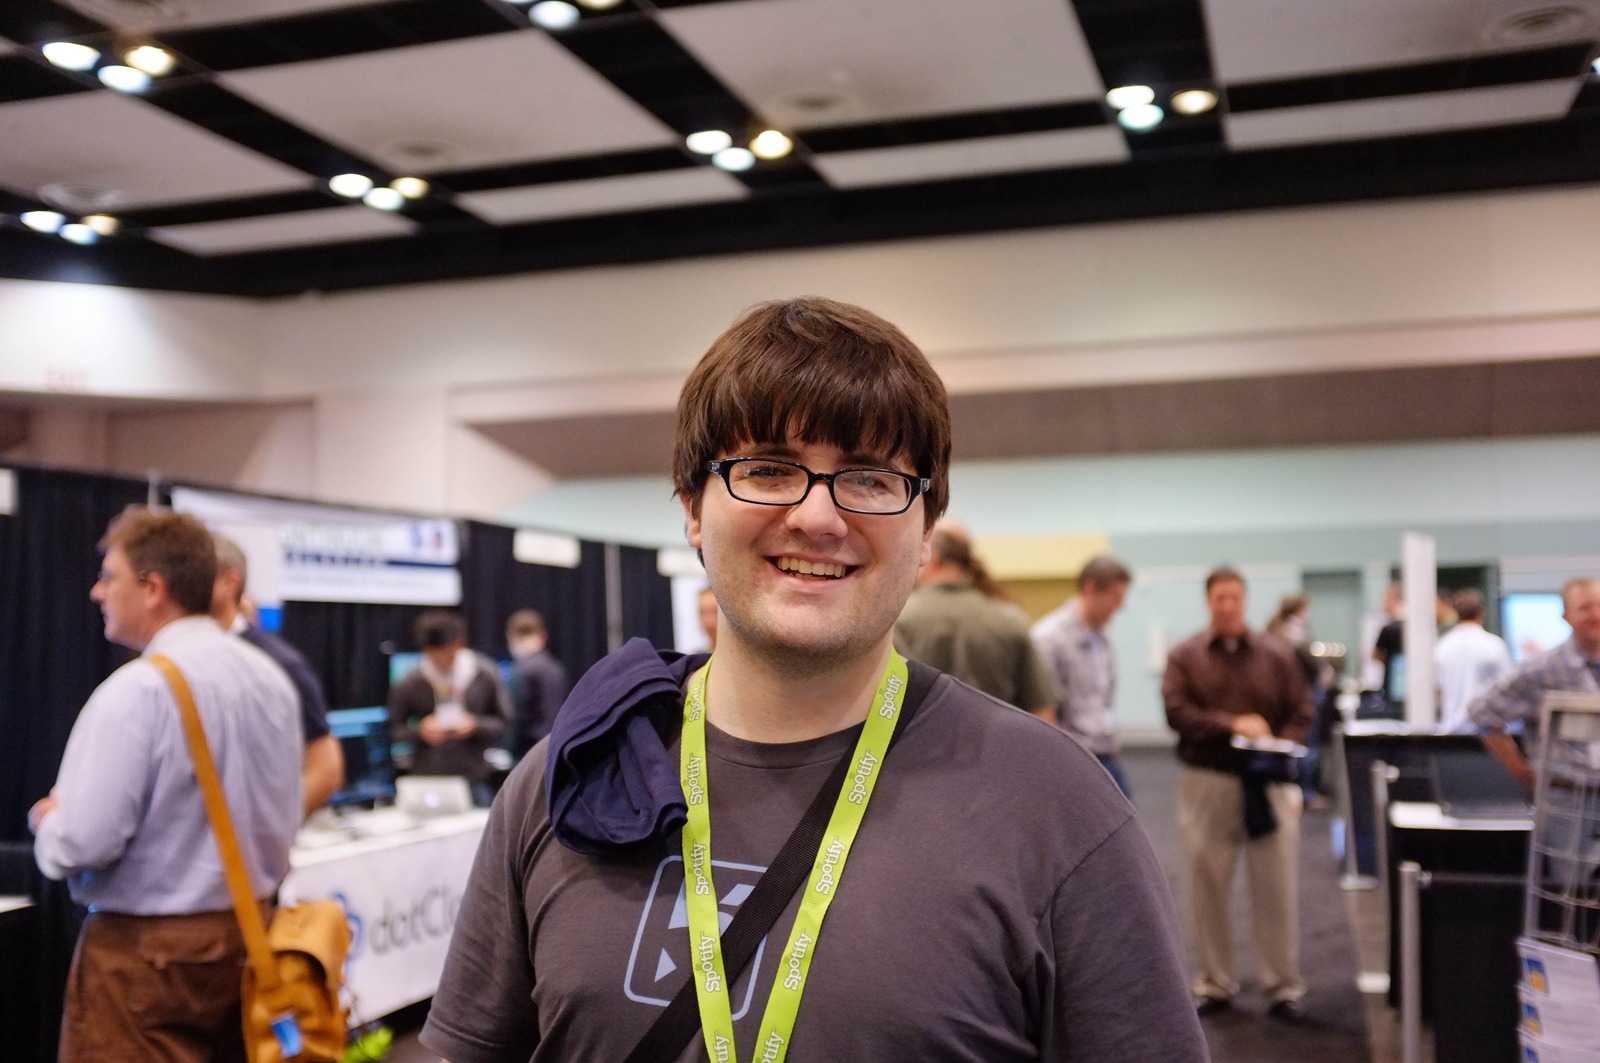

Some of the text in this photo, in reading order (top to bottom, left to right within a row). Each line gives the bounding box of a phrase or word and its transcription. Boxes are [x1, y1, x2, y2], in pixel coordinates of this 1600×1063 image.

[879, 673, 903, 719] Spotify
[688, 755, 704, 805] Spotify
[848, 750, 878, 804] Spotify
[690, 842, 710, 895] Spotify
[816, 838, 845, 894] Spotify
[698, 934, 721, 992] Spotify
[784, 930, 812, 990] Spotify
[713, 1033, 730, 1063] tify
